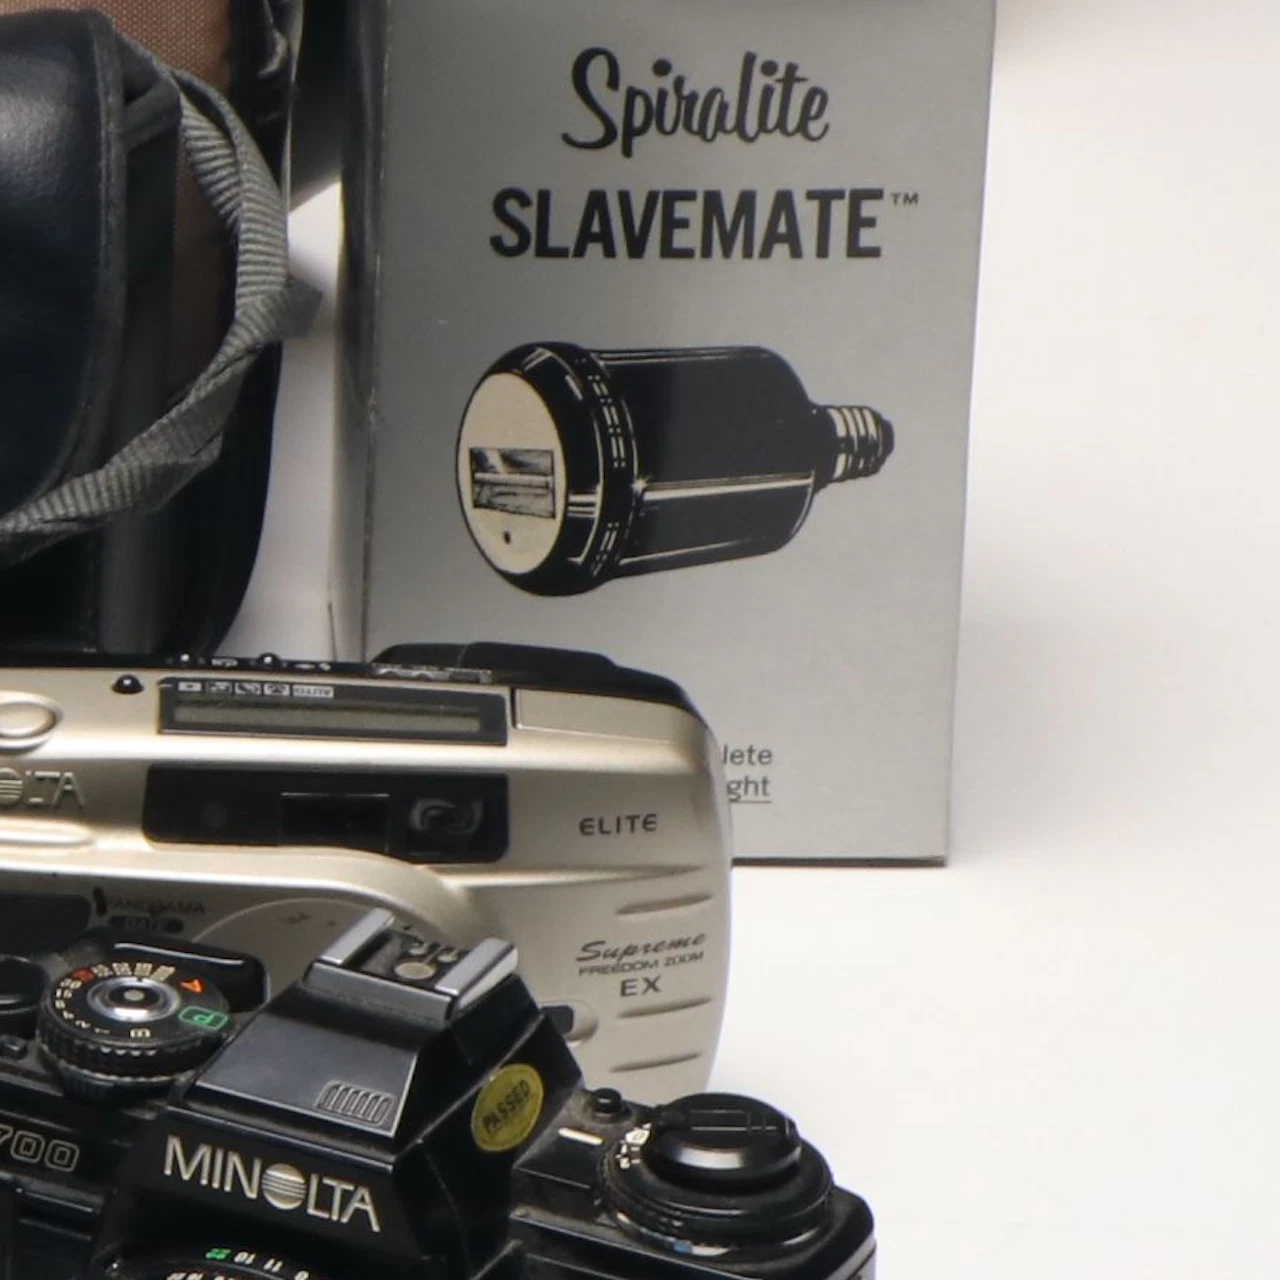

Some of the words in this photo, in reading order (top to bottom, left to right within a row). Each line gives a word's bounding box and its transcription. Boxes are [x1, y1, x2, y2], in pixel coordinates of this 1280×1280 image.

[561, 46, 831, 159] Spiralite
[722, 743, 774, 766] lete
[578, 812, 658, 837] ELITE
[575, 932, 707, 963] Supreme
[578, 958, 659, 978] FREEDOM
[663, 950, 705, 968] ZOOM
[619, 974, 663, 997] EX
[163, 1134, 380, 1234] MINOLTA
